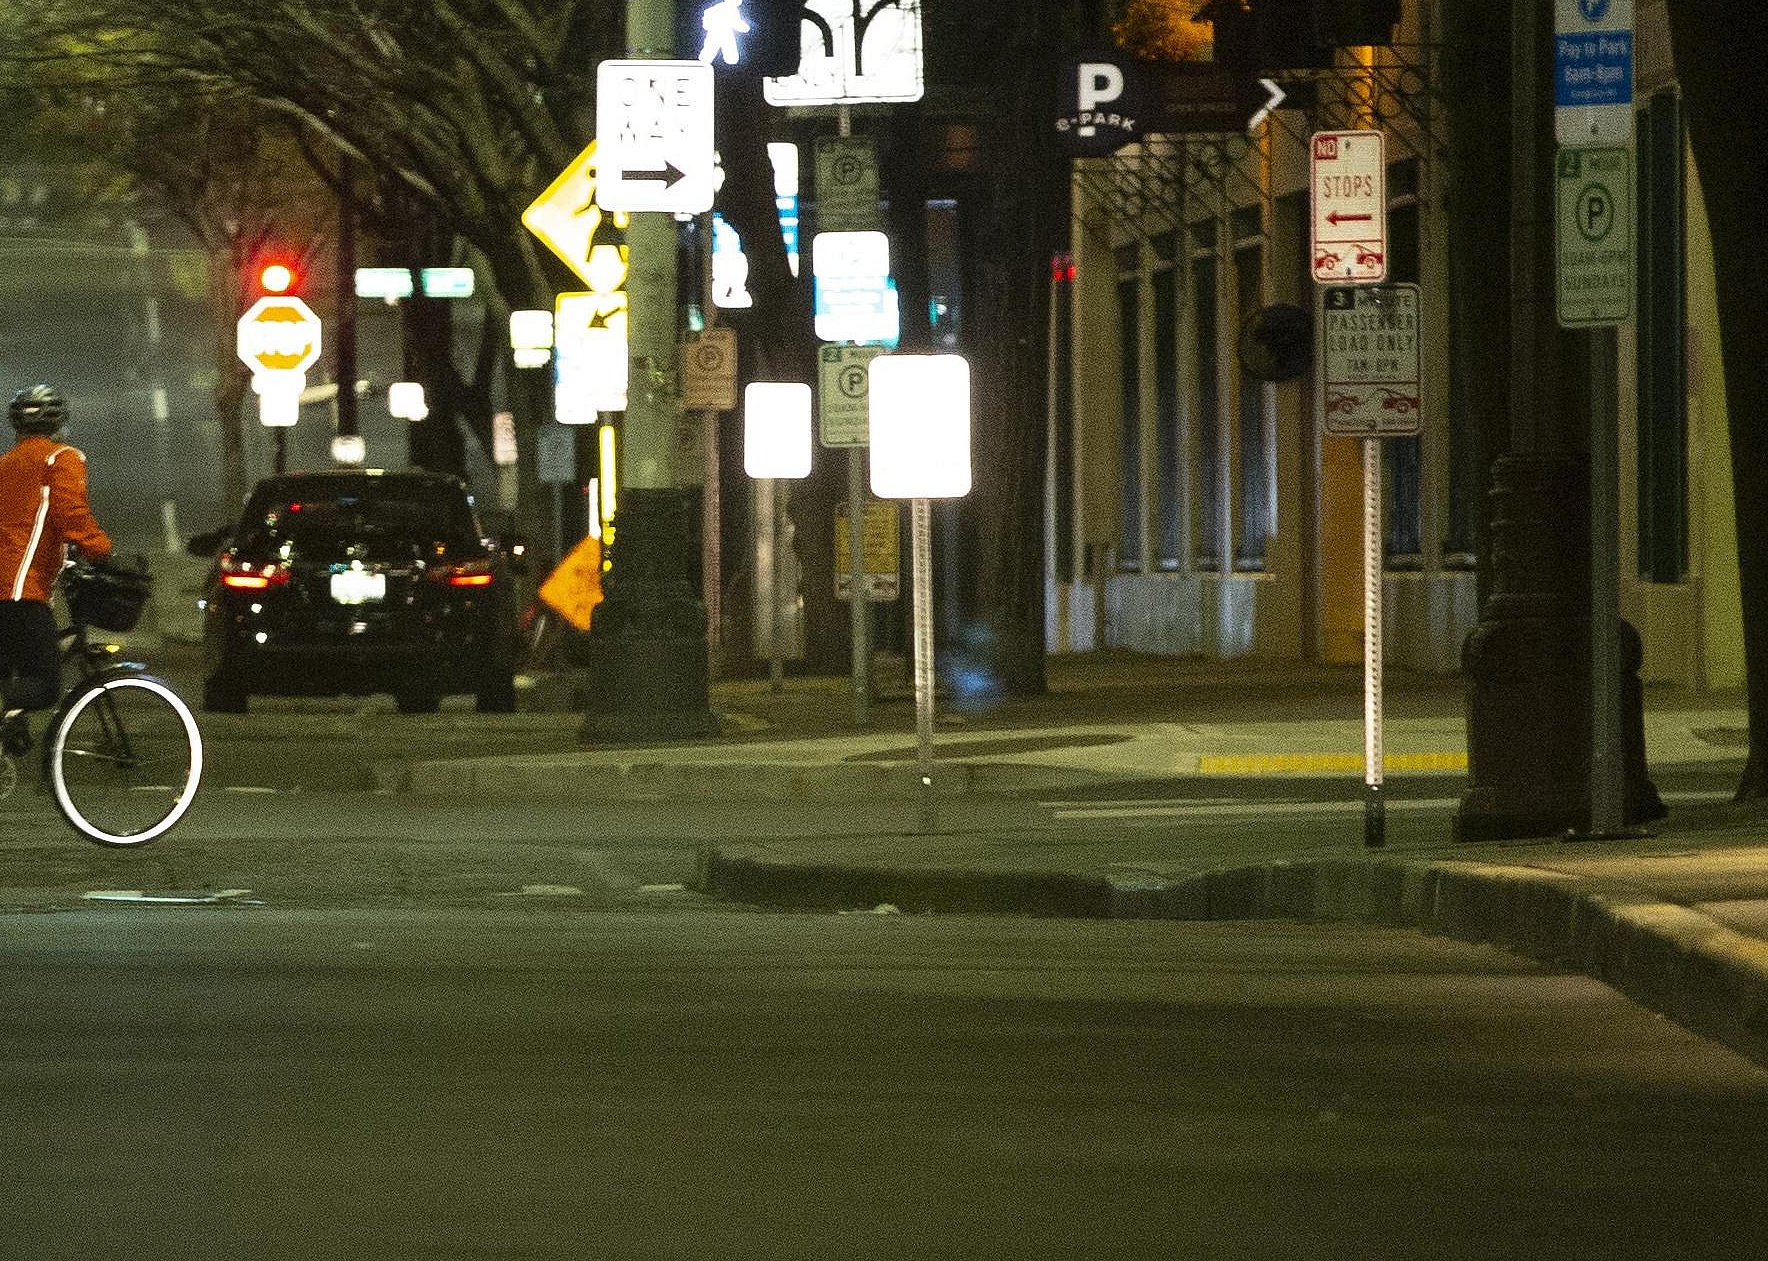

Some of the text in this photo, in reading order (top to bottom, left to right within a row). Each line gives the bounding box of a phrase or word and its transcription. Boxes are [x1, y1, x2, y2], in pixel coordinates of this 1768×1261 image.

[1078, 63, 1124, 136] P
[618, 116, 690, 144] WA
[1317, 141, 1337, 157] NO
[1323, 174, 1373, 198] STOPS
[1588, 197, 1604, 229] P
[1333, 292, 1345, 306] 3
[1329, 313, 1415, 331] PASSENGER
